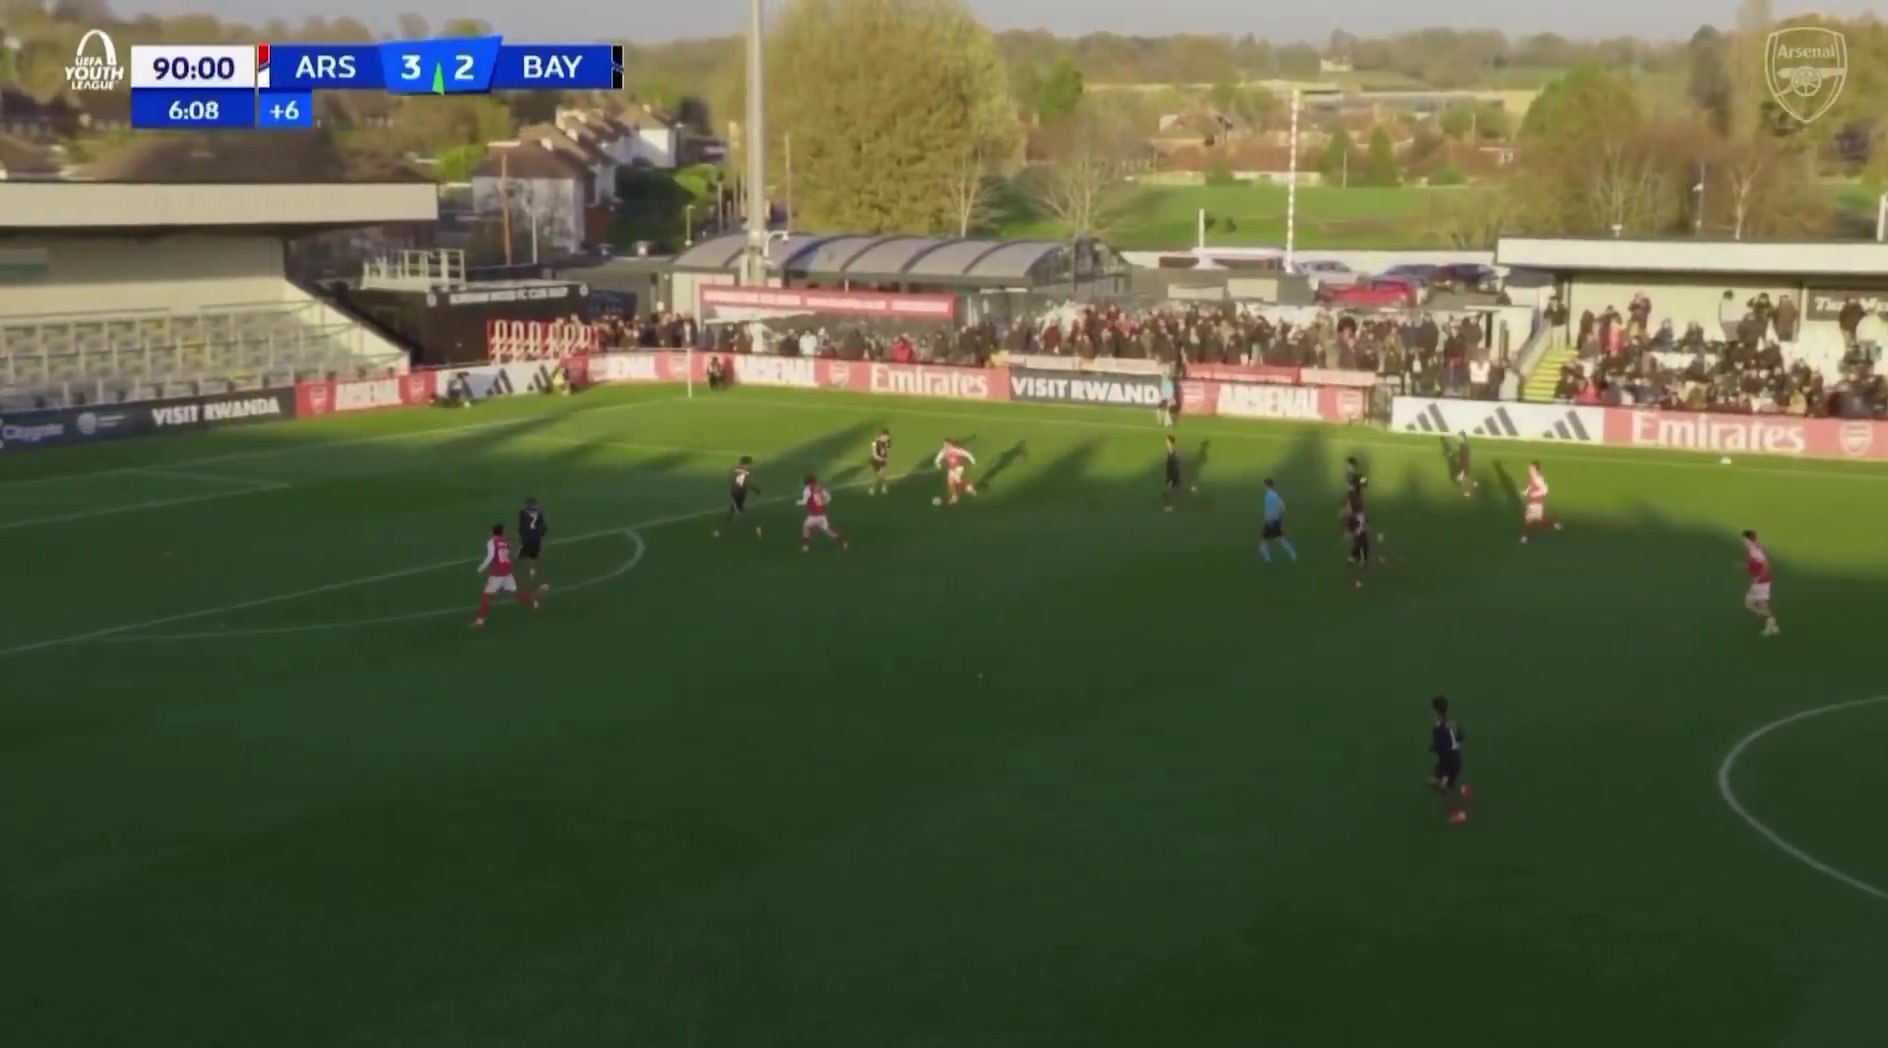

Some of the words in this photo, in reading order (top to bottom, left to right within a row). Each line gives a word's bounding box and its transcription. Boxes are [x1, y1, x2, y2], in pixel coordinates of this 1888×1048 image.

[870, 364, 989, 399] Emirates
[1011, 376, 1069, 399] VISIT
[1071, 379, 1163, 404] RWAND
[152, 404, 199, 427] VISIT
[203, 397, 280, 421] RWANDA
[1217, 383, 1324, 419] ARSENAL
[1632, 410, 1806, 453] Emirates
[529, 513, 538, 530] 7
